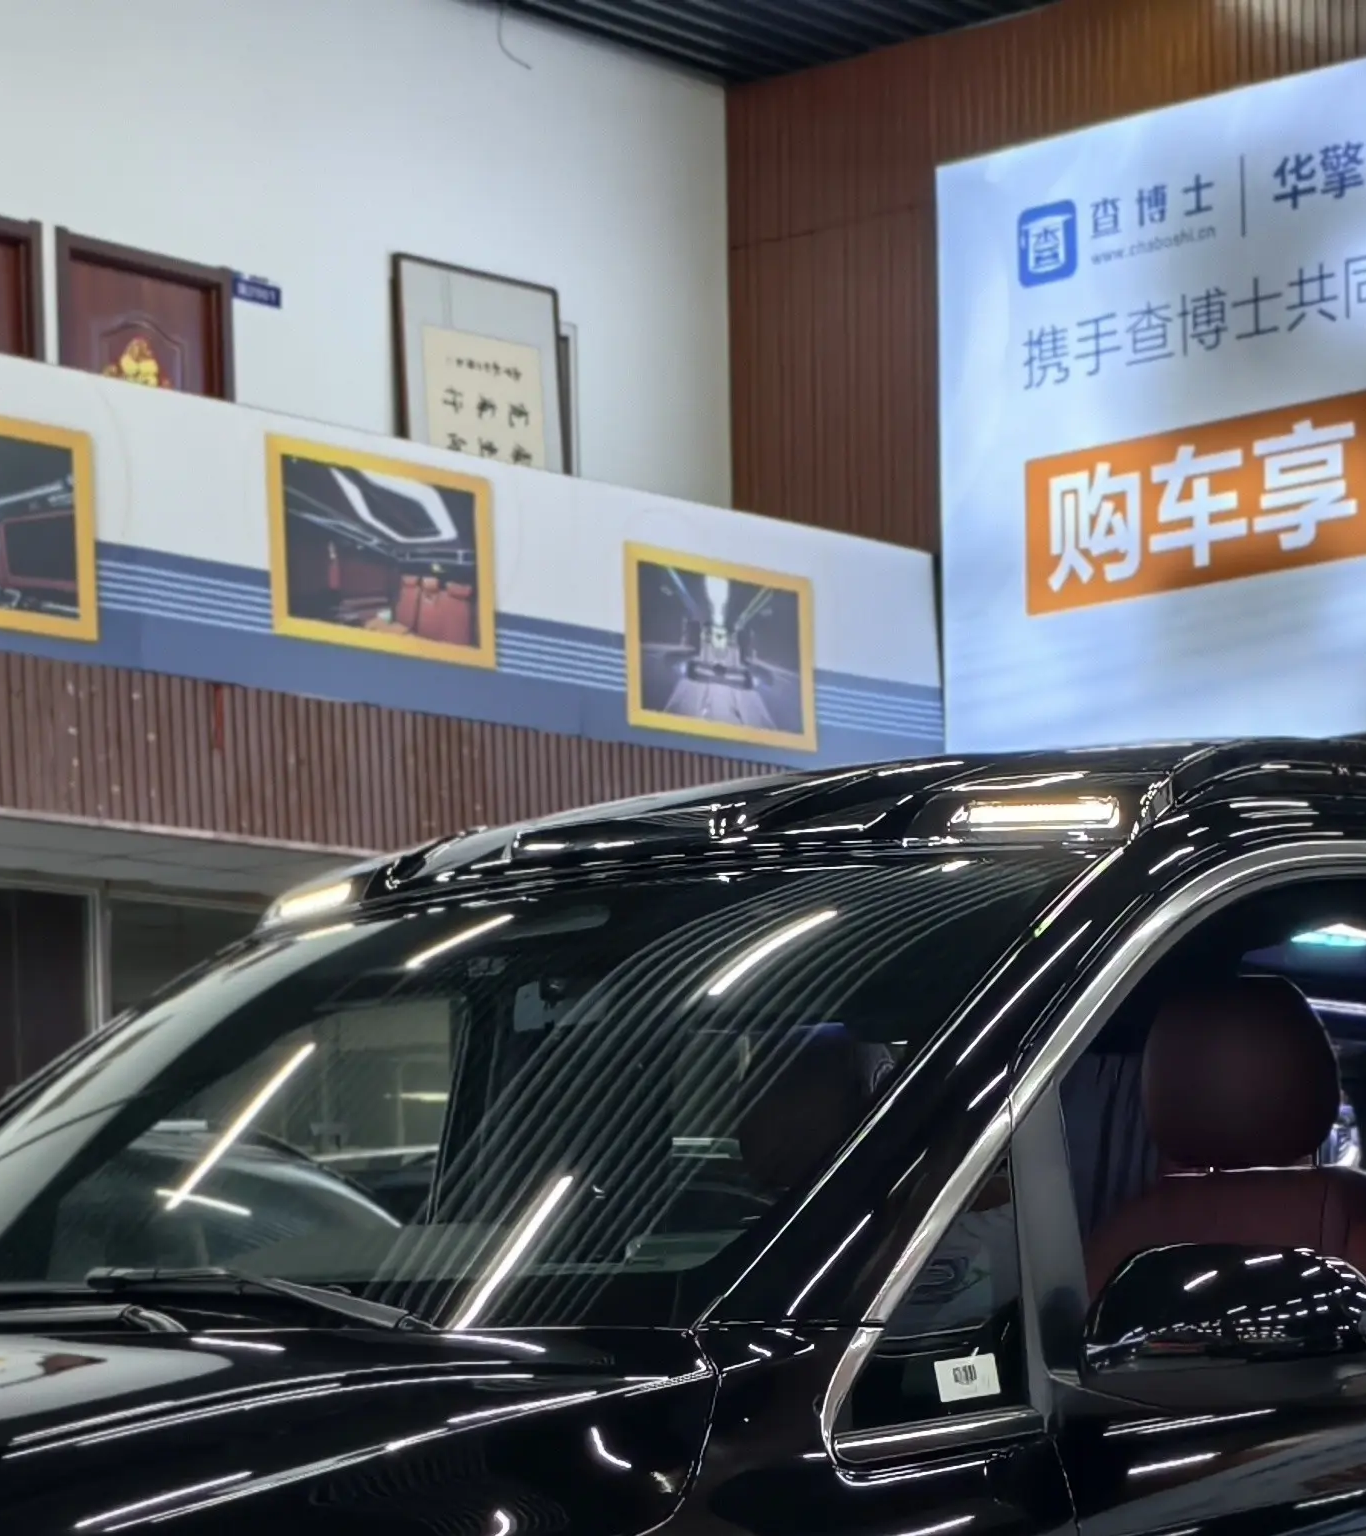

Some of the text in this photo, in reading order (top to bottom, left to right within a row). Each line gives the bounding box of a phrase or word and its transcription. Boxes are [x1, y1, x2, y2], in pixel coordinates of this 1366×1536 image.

[1090, 173, 1215, 240] 查博士
[1047, 419, 1358, 592] 购车享
